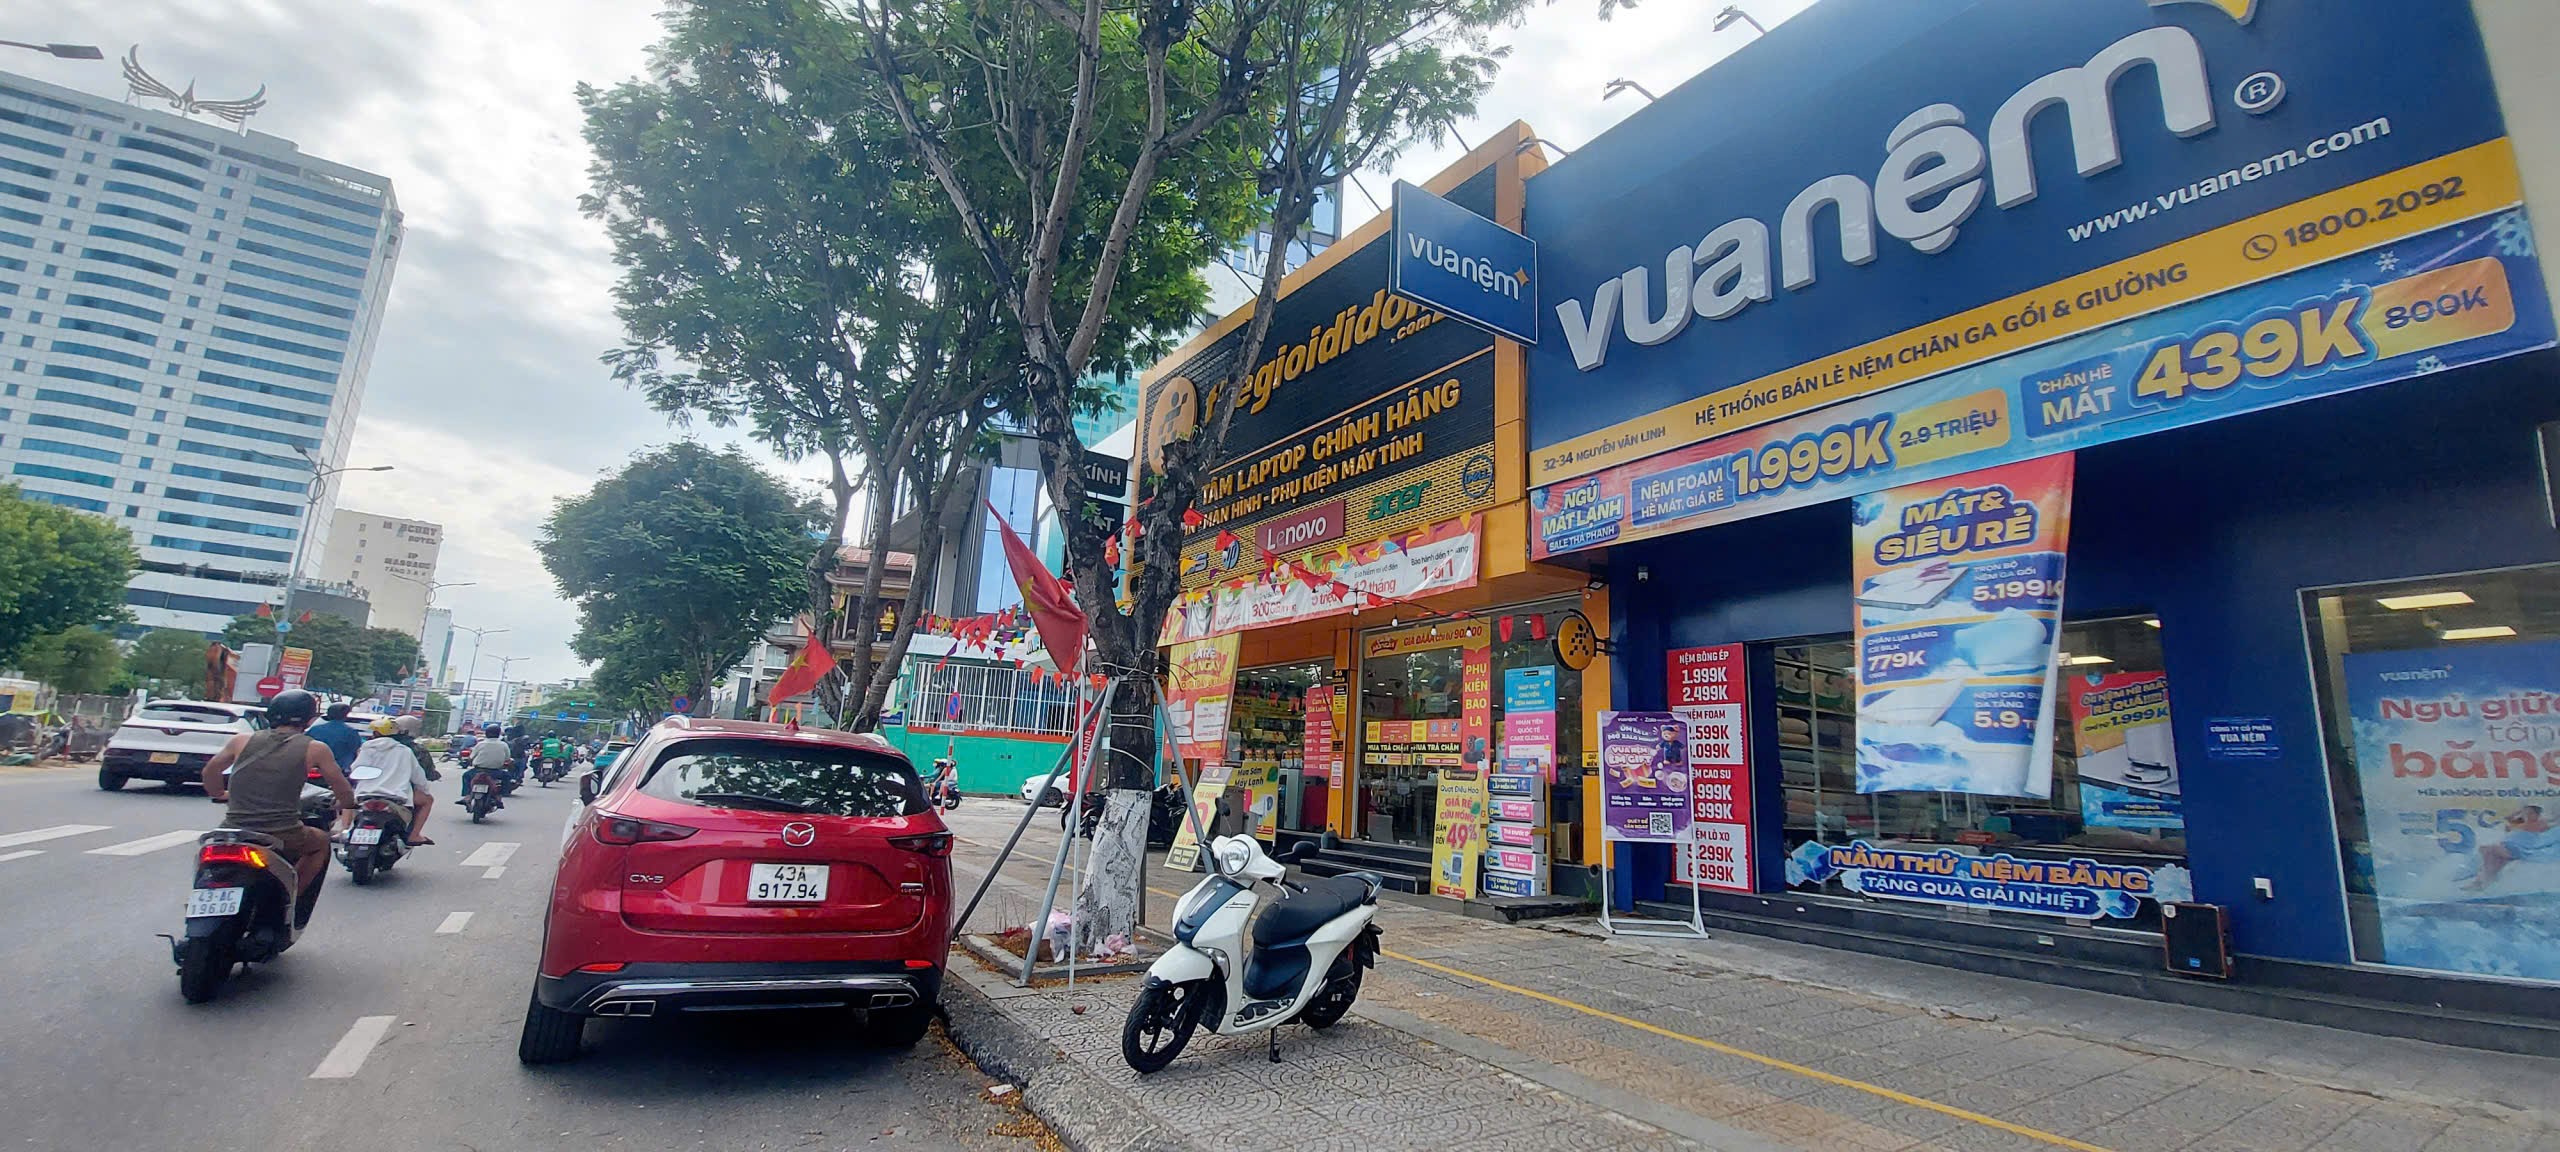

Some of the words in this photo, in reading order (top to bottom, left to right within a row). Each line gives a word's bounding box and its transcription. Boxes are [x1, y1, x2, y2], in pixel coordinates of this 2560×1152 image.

[2068, 116, 2390, 243] www.vuanem.com
[1556, 25, 2215, 371] vuanệm
[2284, 176, 2466, 248] 1800.2092
[1407, 232, 1520, 300] vuanệm
[2385, 284, 2489, 330] 800K
[1695, 407, 1716, 427] HỆ
[1719, 387, 1778, 419] THỐNG
[1782, 375, 1819, 402] BÁN
[1822, 364, 1845, 387] LẺ
[1848, 352, 1894, 382] NỆM
[1898, 333, 1959, 366] CHĂN
[1964, 323, 1997, 345] GA
[2002, 304, 2047, 333] GỐI
[2053, 299, 2071, 318] &
[2076, 262, 2188, 310] GIƯỜNG
[2136, 296, 2366, 400] 439K
[2038, 370, 2087, 394] CHĂN
[2089, 364, 2113, 384] HÈ
[2042, 385, 2116, 426] MÁT
[1202, 476, 1232, 506] TÂM
[1237, 445, 1307, 491] LAPTOP
[1313, 412, 1380, 461] CHÍNH
[1386, 378, 1461, 435] HÃNG
[1899, 426, 1932, 449] 2.9
[1934, 410, 1998, 442] TRIỆU
[1543, 452, 1574, 472] 32-34
[1576, 438, 1616, 462] NGUYỄN
[1617, 431, 1640, 451] VĂN
[1640, 426, 1667, 444] LINH
[1731, 419, 1890, 496] 1.999K
[1204, 508, 1229, 530] MÀN
[1231, 494, 1263, 521] HÌNH
[1271, 479, 1300, 505] PHỤ
[1302, 463, 1338, 494] KIỆN
[1341, 449, 1376, 481] MÁY
[1377, 432, 1424, 464] TÍNH
[1563, 479, 1599, 510] NGỦ
[1641, 477, 1675, 500] NỆM
[1677, 468, 1724, 493] FOAM
[1366, 480, 1433, 522] acer
[1687, 493, 1706, 510] GIÁ
[1708, 486, 1725, 503] RẺ
[1542, 510, 1577, 537] MÁT
[1576, 498, 1621, 528] LẠNH
[1266, 514, 1328, 551] Lenovo
[1549, 540, 1568, 551] SALE
[1586, 525, 1615, 542] PHANH
[1878, 525, 1971, 562] SIÊU
[1976, 507, 2032, 545] RẺ
[1369, 579, 1397, 594] tháng
[1465, 663, 1487, 677] PHỤ
[1679, 653, 1695, 664] NỆM
[1697, 651, 1718, 662] BÔNG
[1719, 648, 1729, 662] ÉP
[1867, 648, 1926, 673] 779K
[1464, 677, 1488, 695] KIỆN
[1682, 667, 1727, 684] 1.999K
[2379, 668, 2449, 682] vuanệm
[1465, 698, 1487, 710] BAO
[1682, 685, 1728, 702] 2.499K
[2380, 692, 2470, 723] Ngủ
[1469, 716, 1483, 727] LA
[1704, 710, 1726, 719] FOAM
[1973, 710, 2020, 730] 5.9
[1690, 743, 1730, 758] .099K
[2220, 733, 2239, 743] VUA
[2241, 732, 2266, 744] NỆM
[1703, 769, 1718, 779] CAO
[1720, 769, 1731, 779] SU
[1445, 796, 1461, 808] GIÁ
[2441, 788, 2494, 798] KHÔNG
[1708, 829, 1718, 840] LÒ
[1719, 832, 1730, 841] XO
[629, 872, 665, 886] CX-5
[772, 865, 808, 883] 43A
[1832, 844, 1897, 871] NẰM
[1900, 848, 1958, 876] THỬ
[1971, 858, 2042, 885] NỆM
[2048, 858, 2149, 891] BĂNG
[757, 881, 819, 900] 917.94
[1864, 874, 1921, 896] TẶNG
[1922, 878, 1968, 899] QUÀ
[1971, 882, 2015, 902] GIẢI
[2018, 889, 2090, 912] NHIỆT
